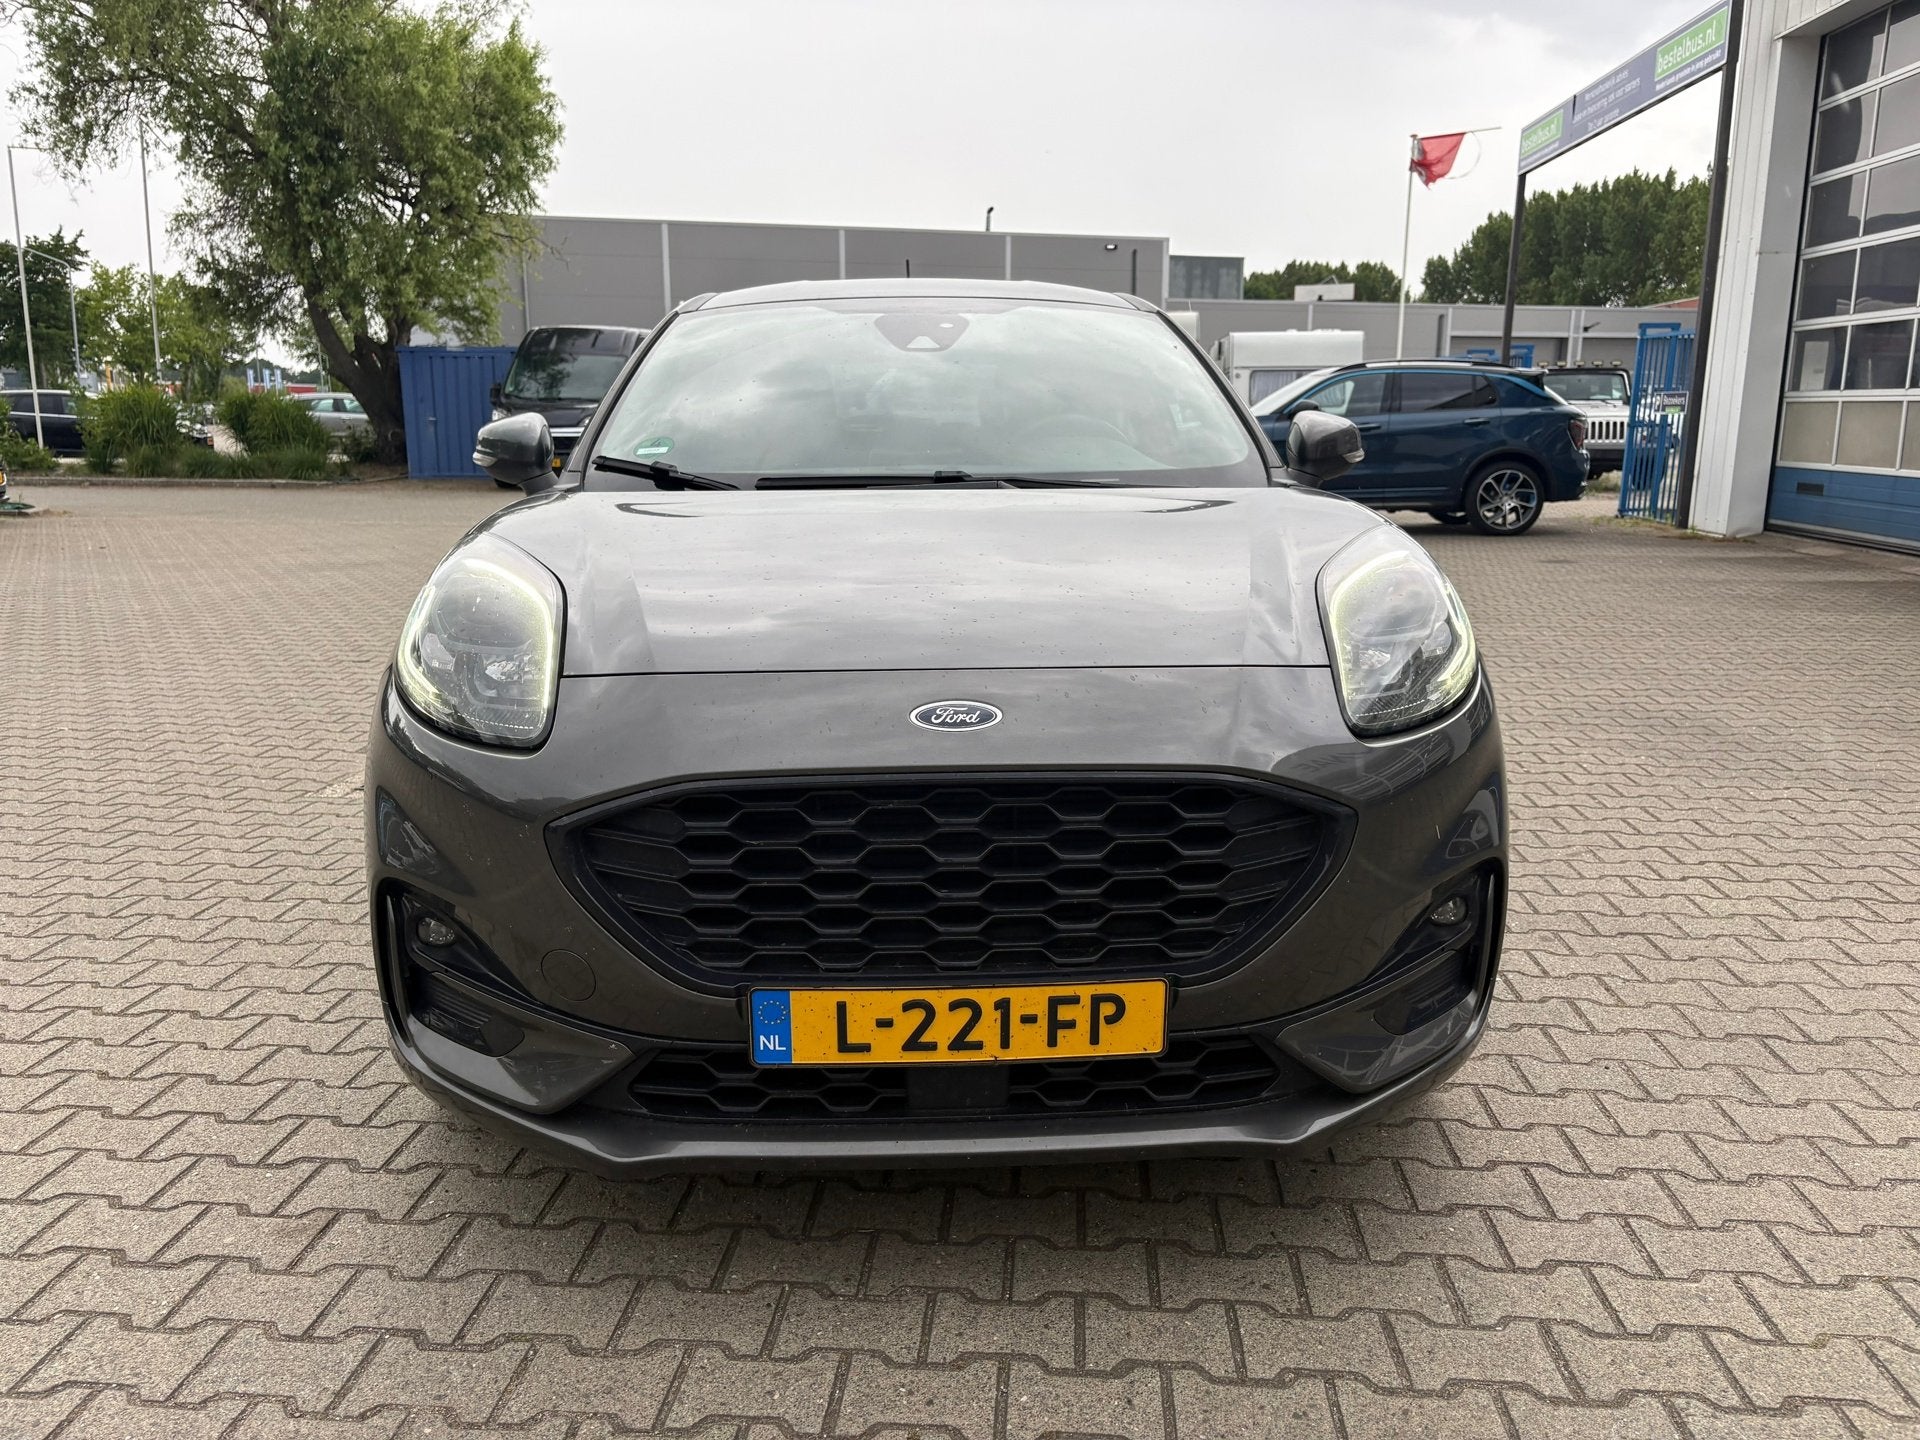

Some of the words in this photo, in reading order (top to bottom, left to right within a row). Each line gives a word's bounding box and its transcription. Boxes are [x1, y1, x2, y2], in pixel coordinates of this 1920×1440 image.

[1657, 20, 1717, 73] bestelbus.nl
[931, 706, 981, 724] Ford
[835, 992, 1127, 1054] L-221-FP
[759, 1034, 787, 1051] NL
